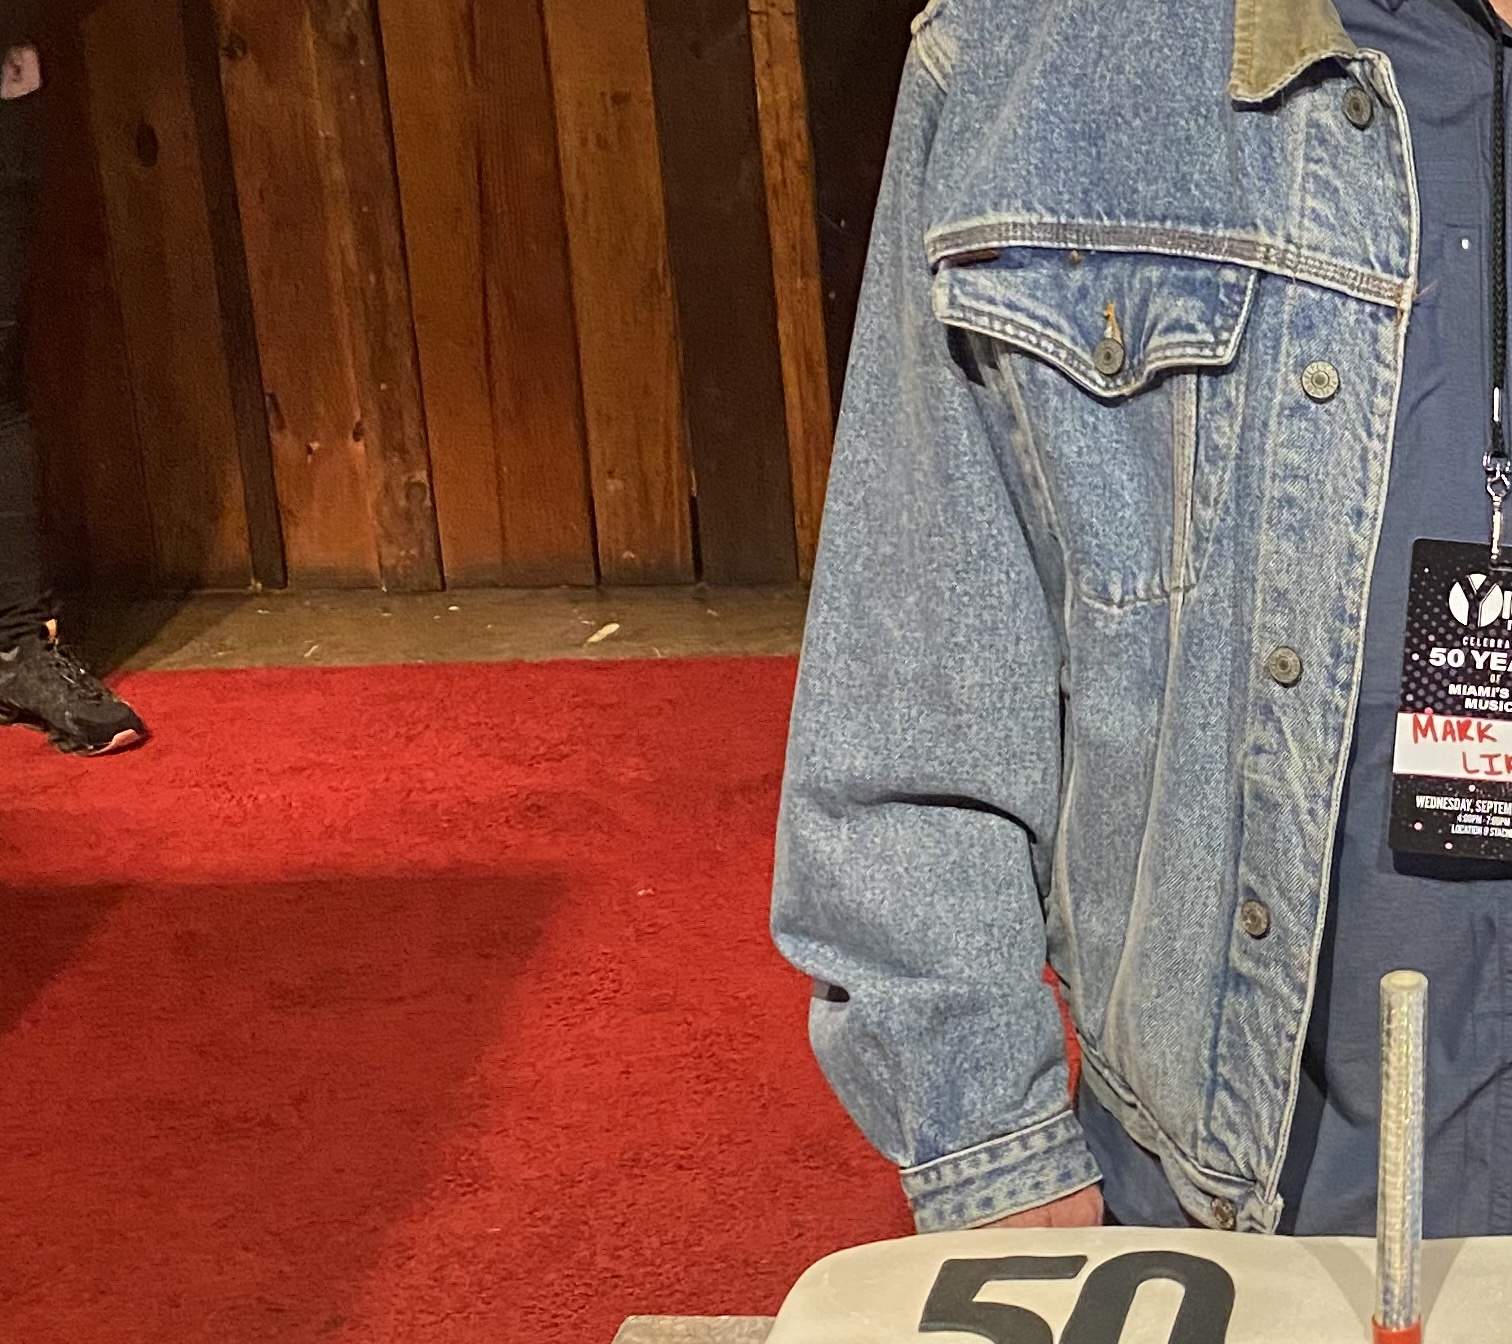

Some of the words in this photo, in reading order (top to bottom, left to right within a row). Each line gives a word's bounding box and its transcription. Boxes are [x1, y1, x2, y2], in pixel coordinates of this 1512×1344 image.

[1429, 647, 1466, 668] 50
[1448, 683, 1510, 699] MIAMI'S
[1412, 713, 1498, 744] MARK
[1415, 795, 1474, 813] WEDNESDAY,
[1451, 824, 1483, 836] LOCATION
